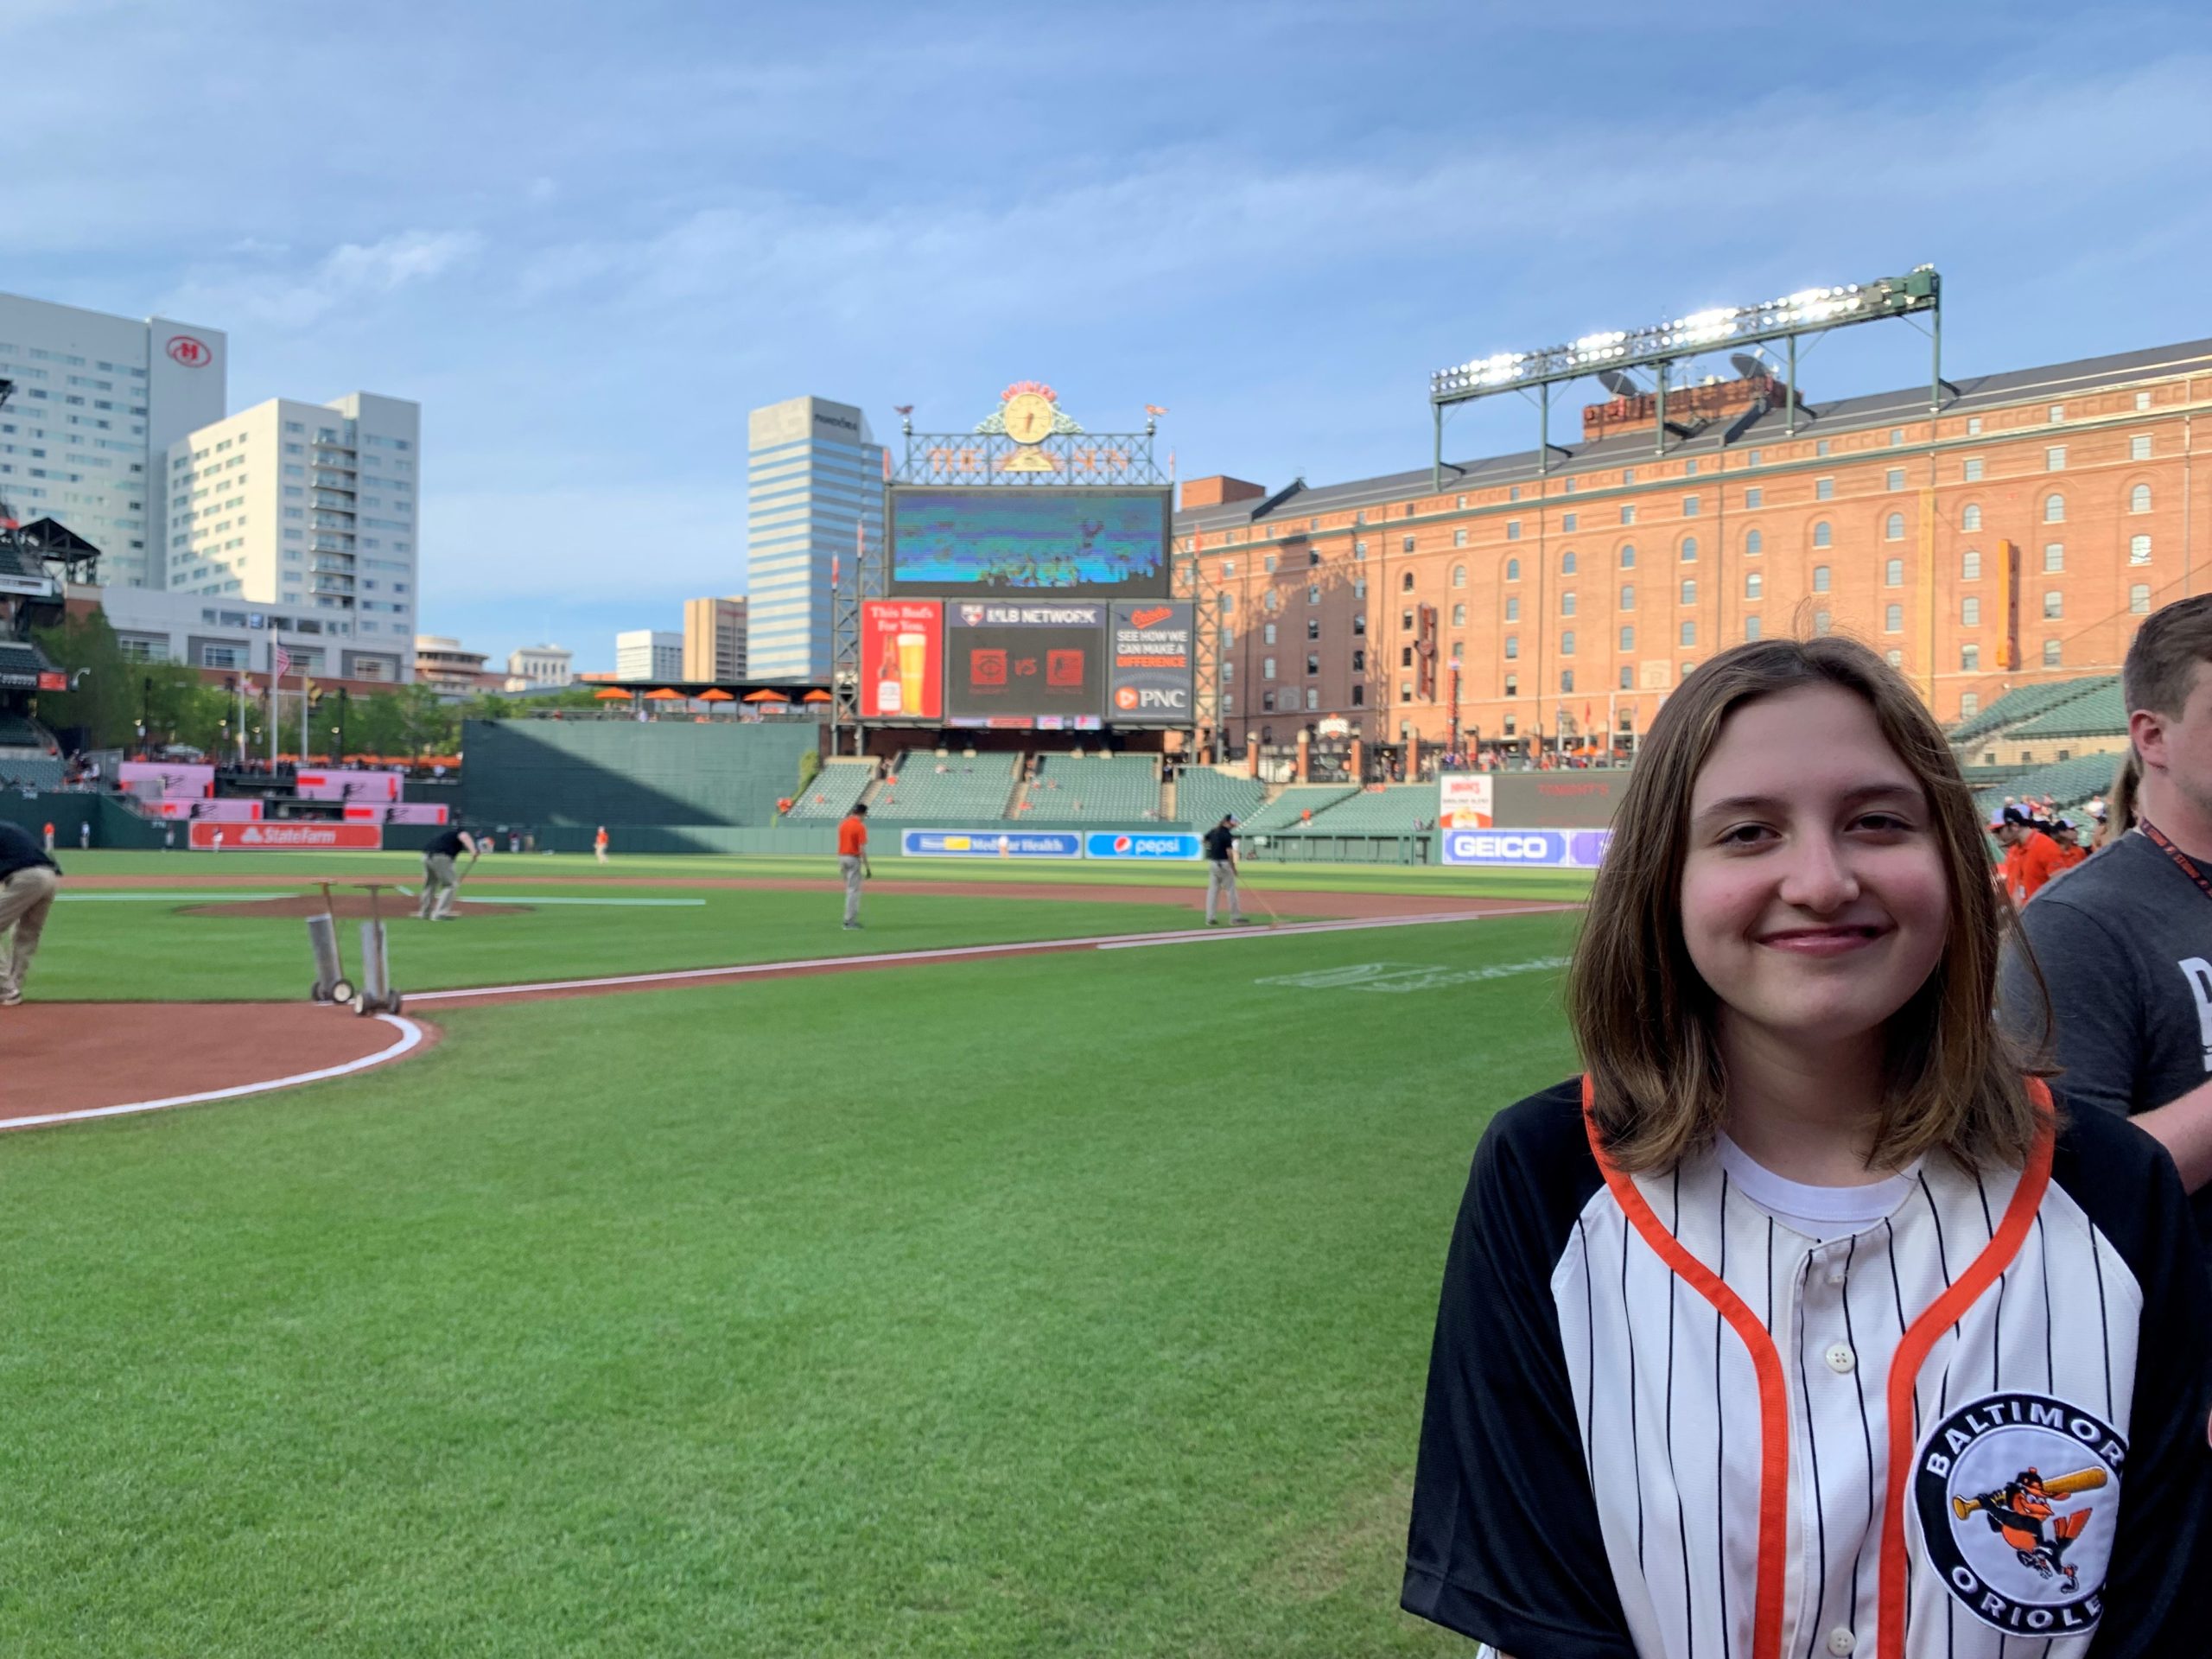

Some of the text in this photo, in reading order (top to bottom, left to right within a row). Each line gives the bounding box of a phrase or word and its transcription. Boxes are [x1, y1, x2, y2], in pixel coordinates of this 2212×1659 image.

[1022, 608, 1096, 624] NETWORK
[1117, 630, 1139, 642] SEE
[1117, 644, 1141, 655] CAN
[1141, 644, 1176, 655] MAKE
[1140, 689, 1186, 708] PNC
[1135, 838, 1180, 856] pepsi
[1454, 836, 1548, 859] GEICO
[1926, 1402, 2125, 1478] BALTIMOR
[1952, 1566, 2102, 1629] ORIOLE
